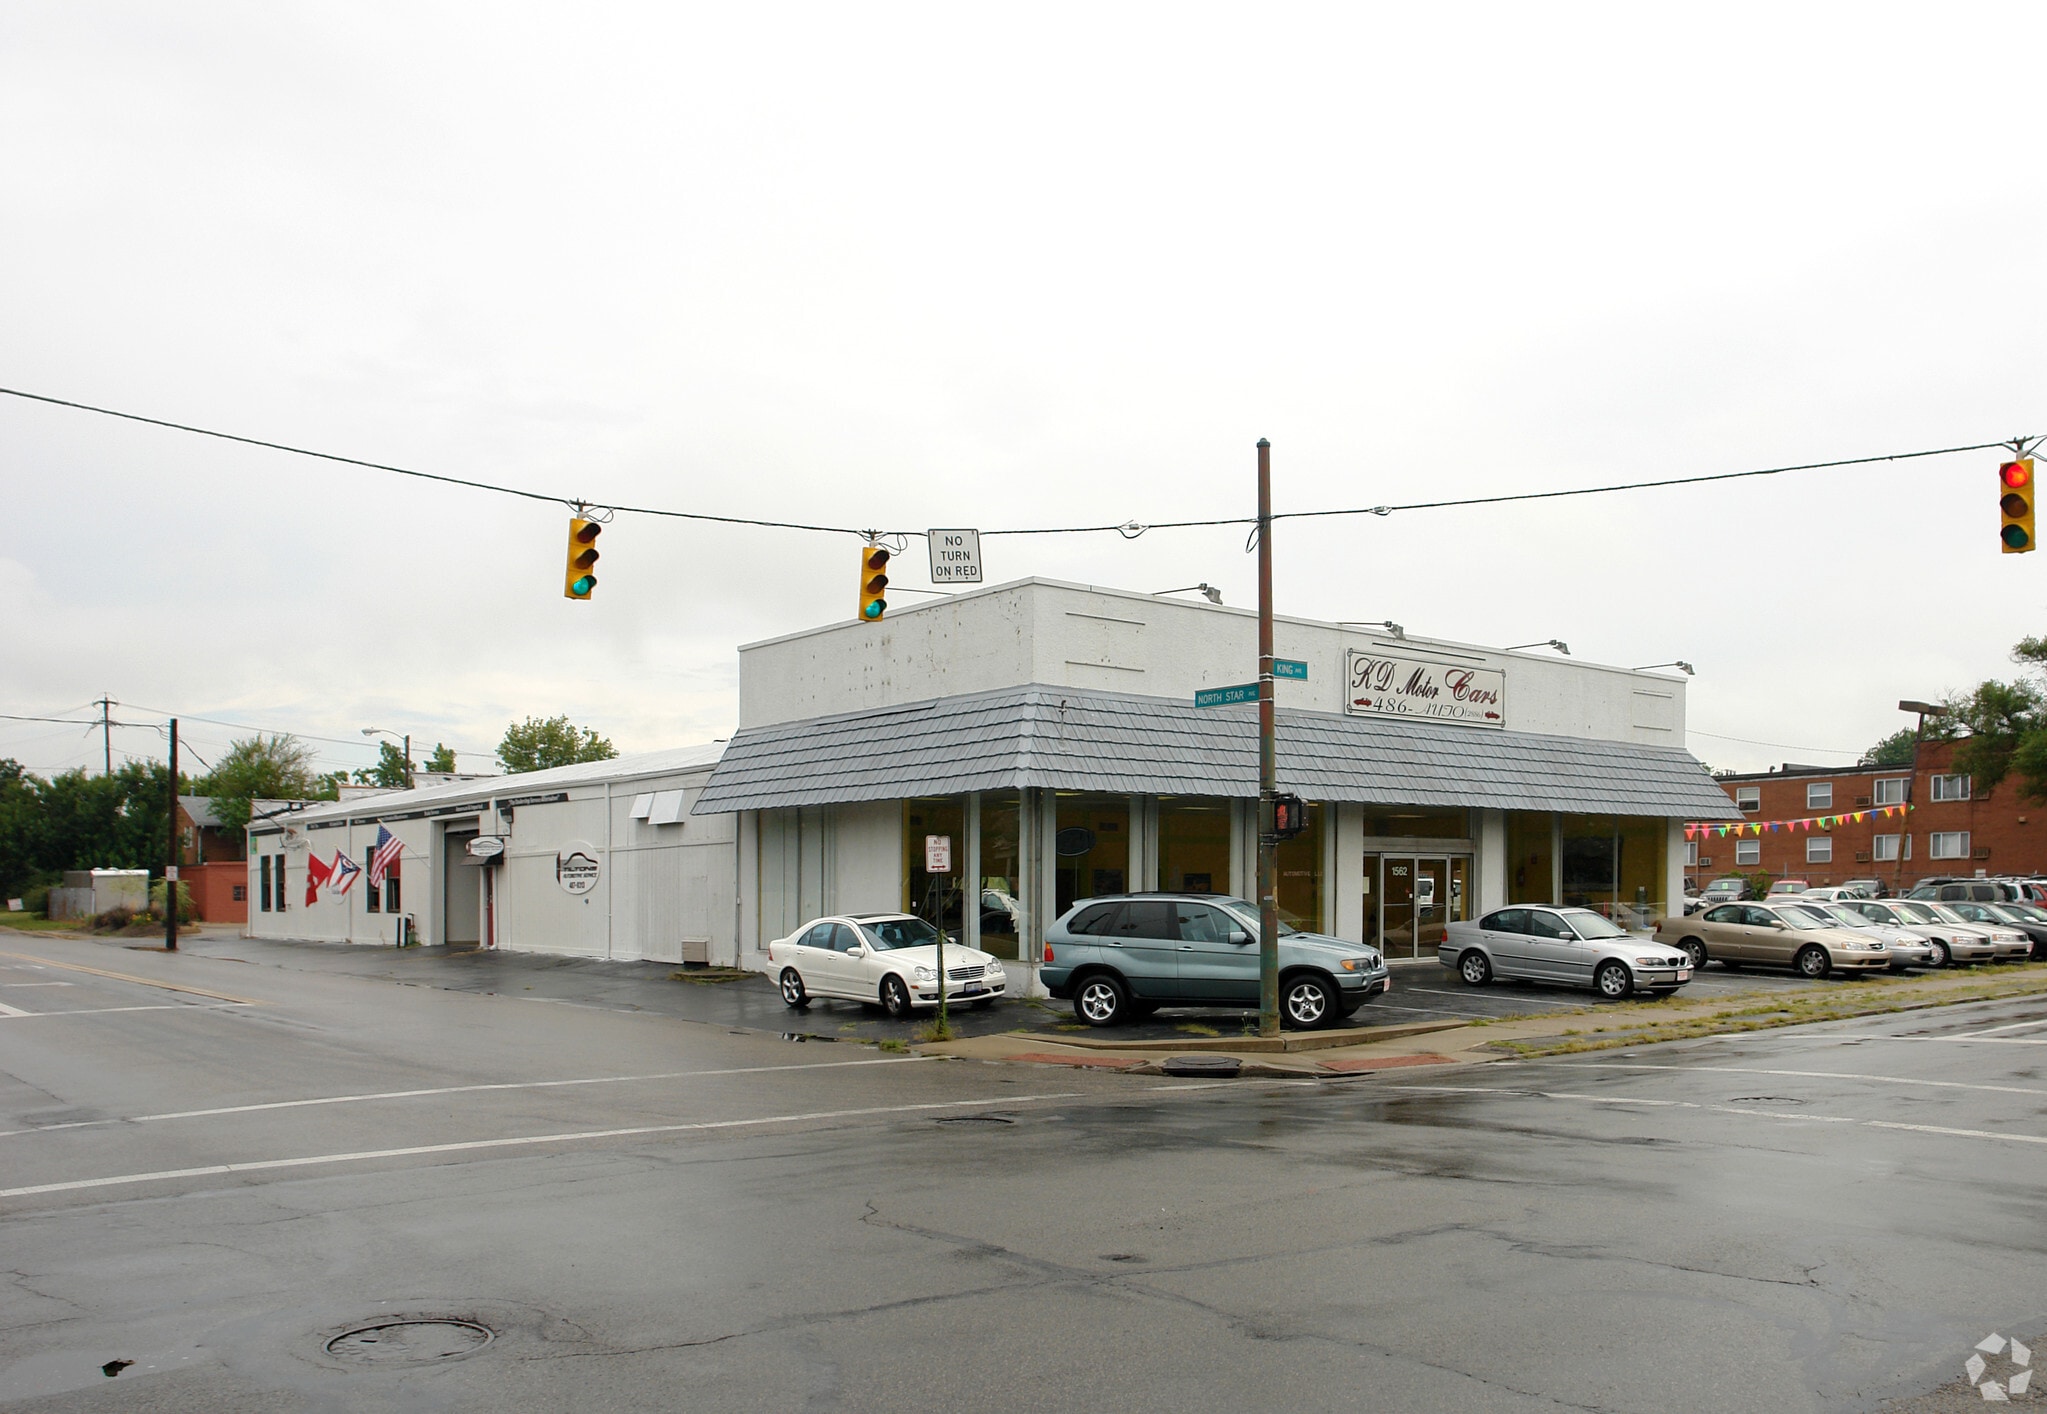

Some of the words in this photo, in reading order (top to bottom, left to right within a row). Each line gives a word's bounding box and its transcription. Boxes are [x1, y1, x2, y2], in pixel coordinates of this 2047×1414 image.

[945, 536, 963, 546] NO
[940, 551, 971, 561] TURN
[936, 566, 951, 576] ON
[955, 565, 977, 576] RED
[1276, 663, 1294, 675] KING
[1396, 667, 1439, 700] Motor
[1444, 669, 1498, 705] Cars
[1198, 693, 1222, 705] NORTH
[1225, 690, 1244, 701] STAR
[1391, 866, 1408, 877] 1562
